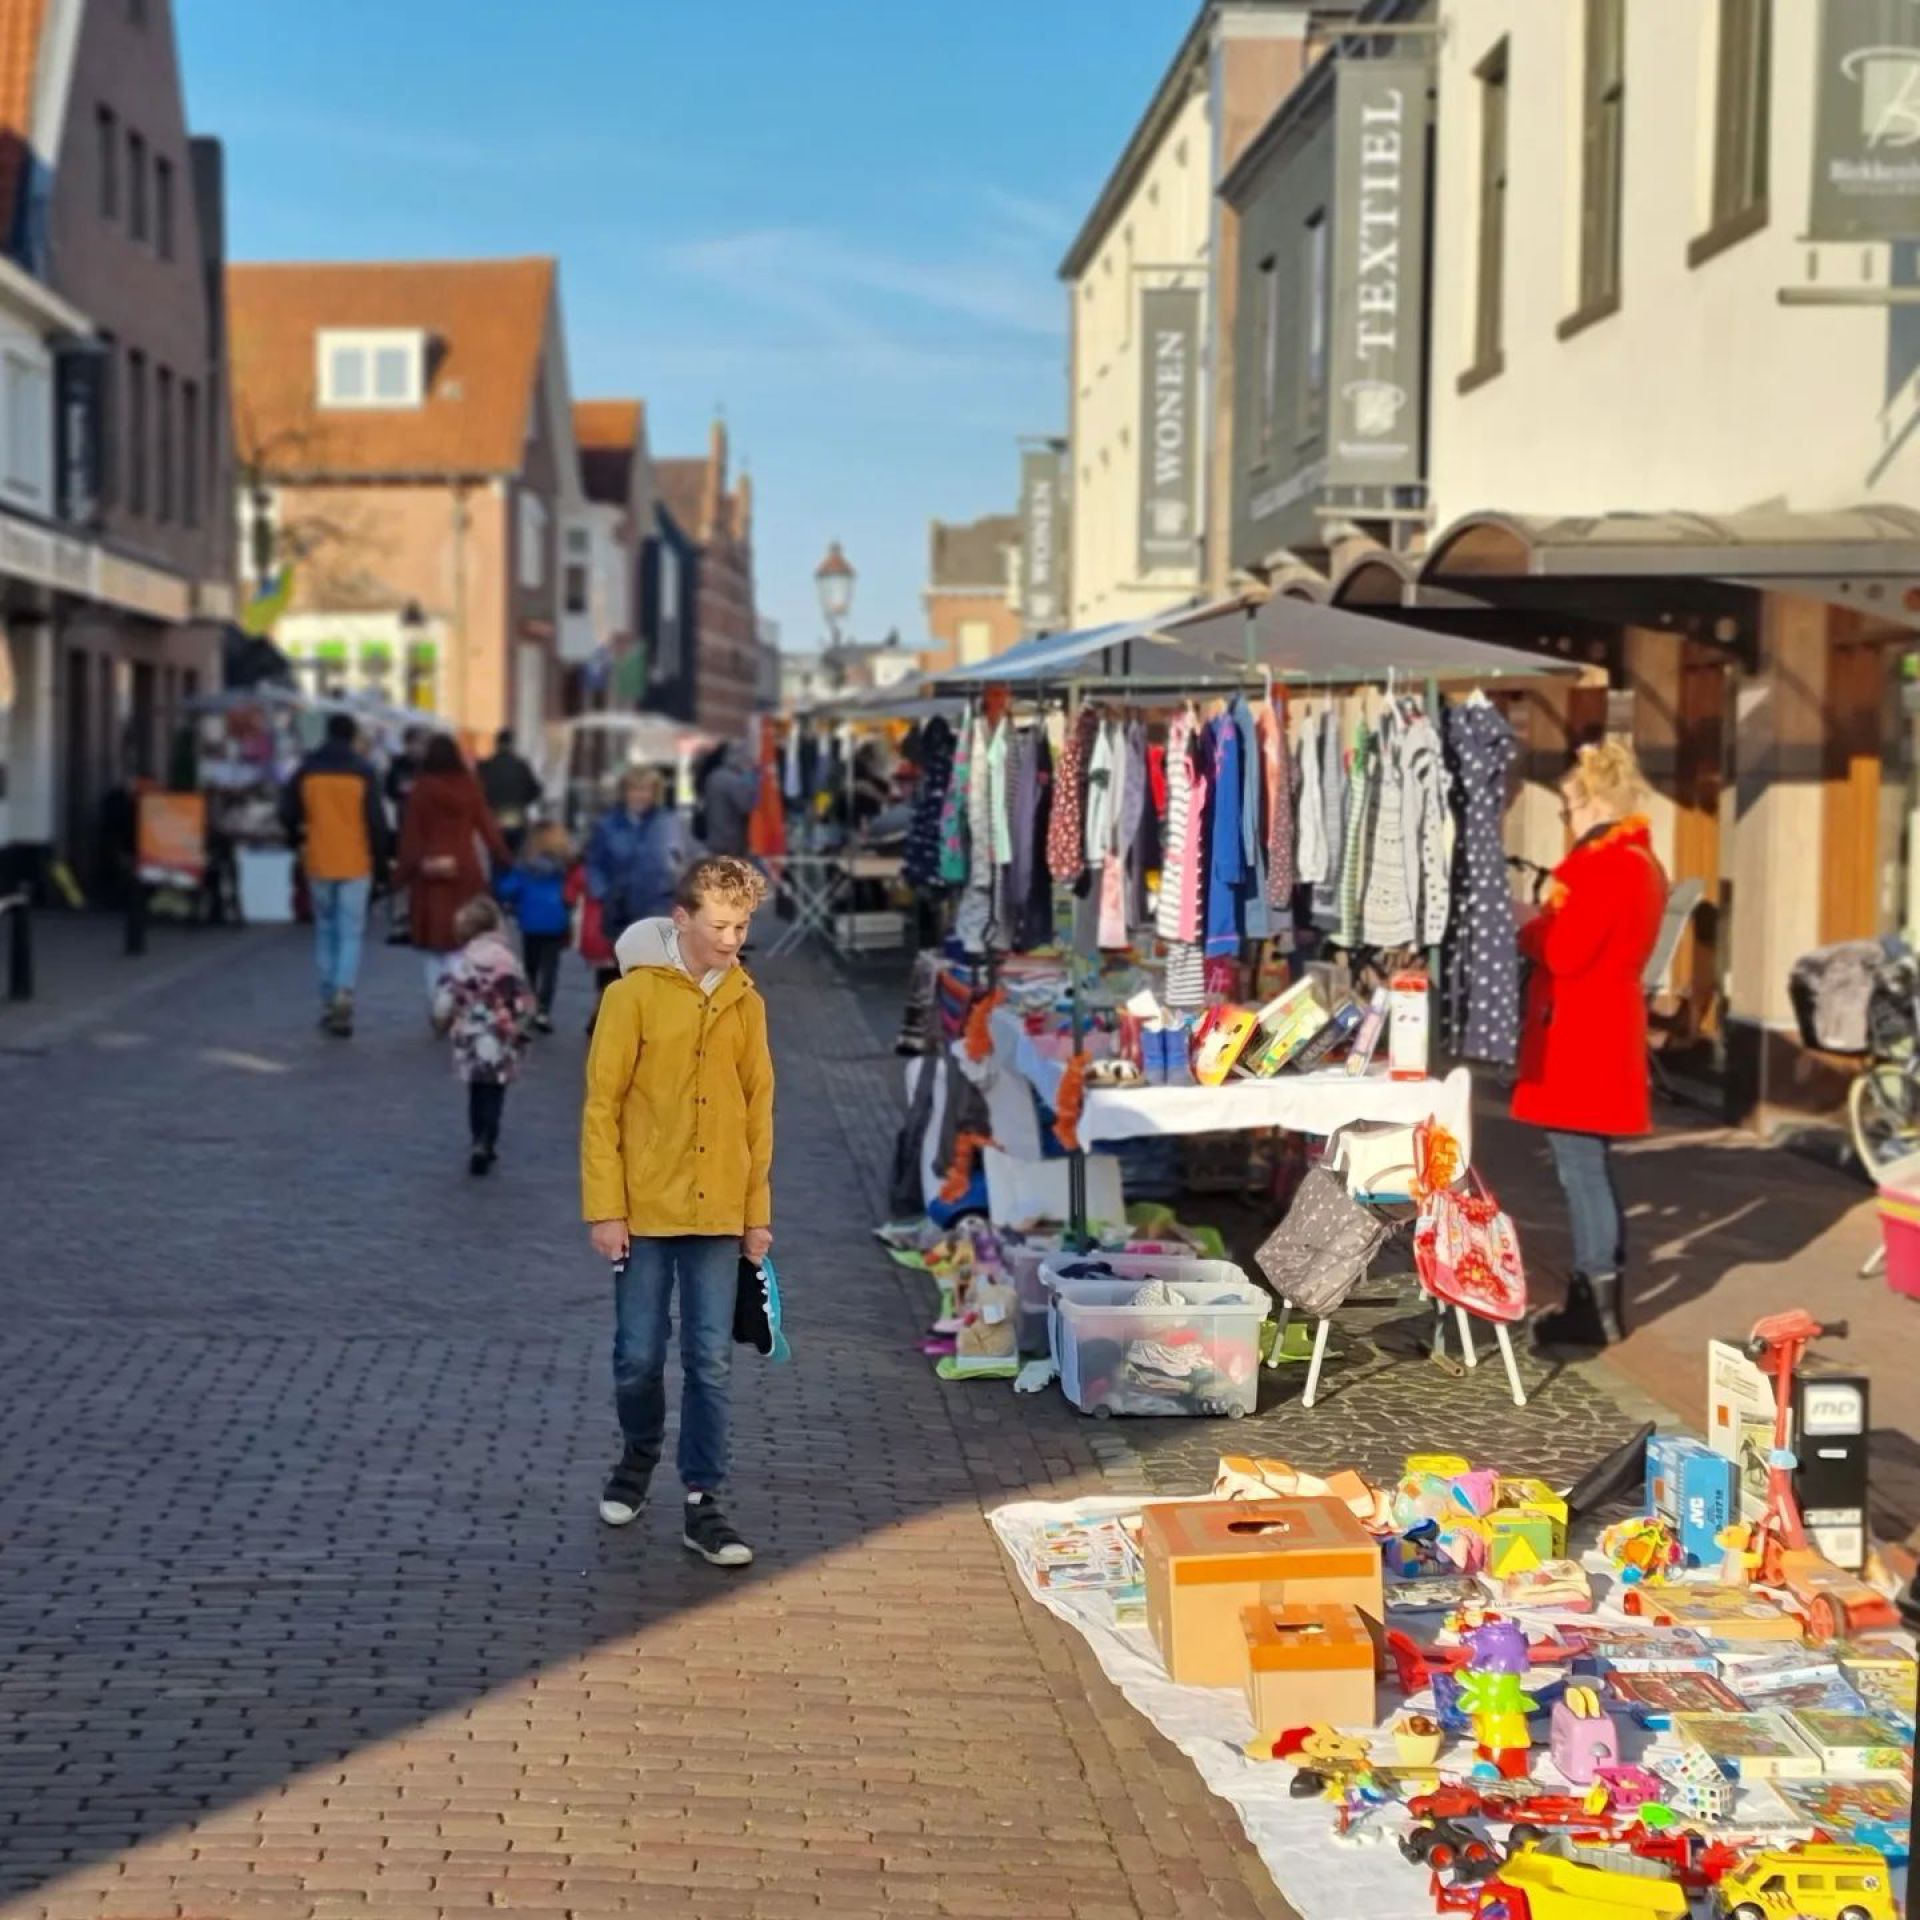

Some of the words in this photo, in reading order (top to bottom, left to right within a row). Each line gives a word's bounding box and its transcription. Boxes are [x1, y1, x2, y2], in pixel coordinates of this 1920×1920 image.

[1356, 88, 1403, 361] TEXTIEL
[1154, 330, 1185, 485] WONEN
[1689, 1497, 1705, 1529] JVC
